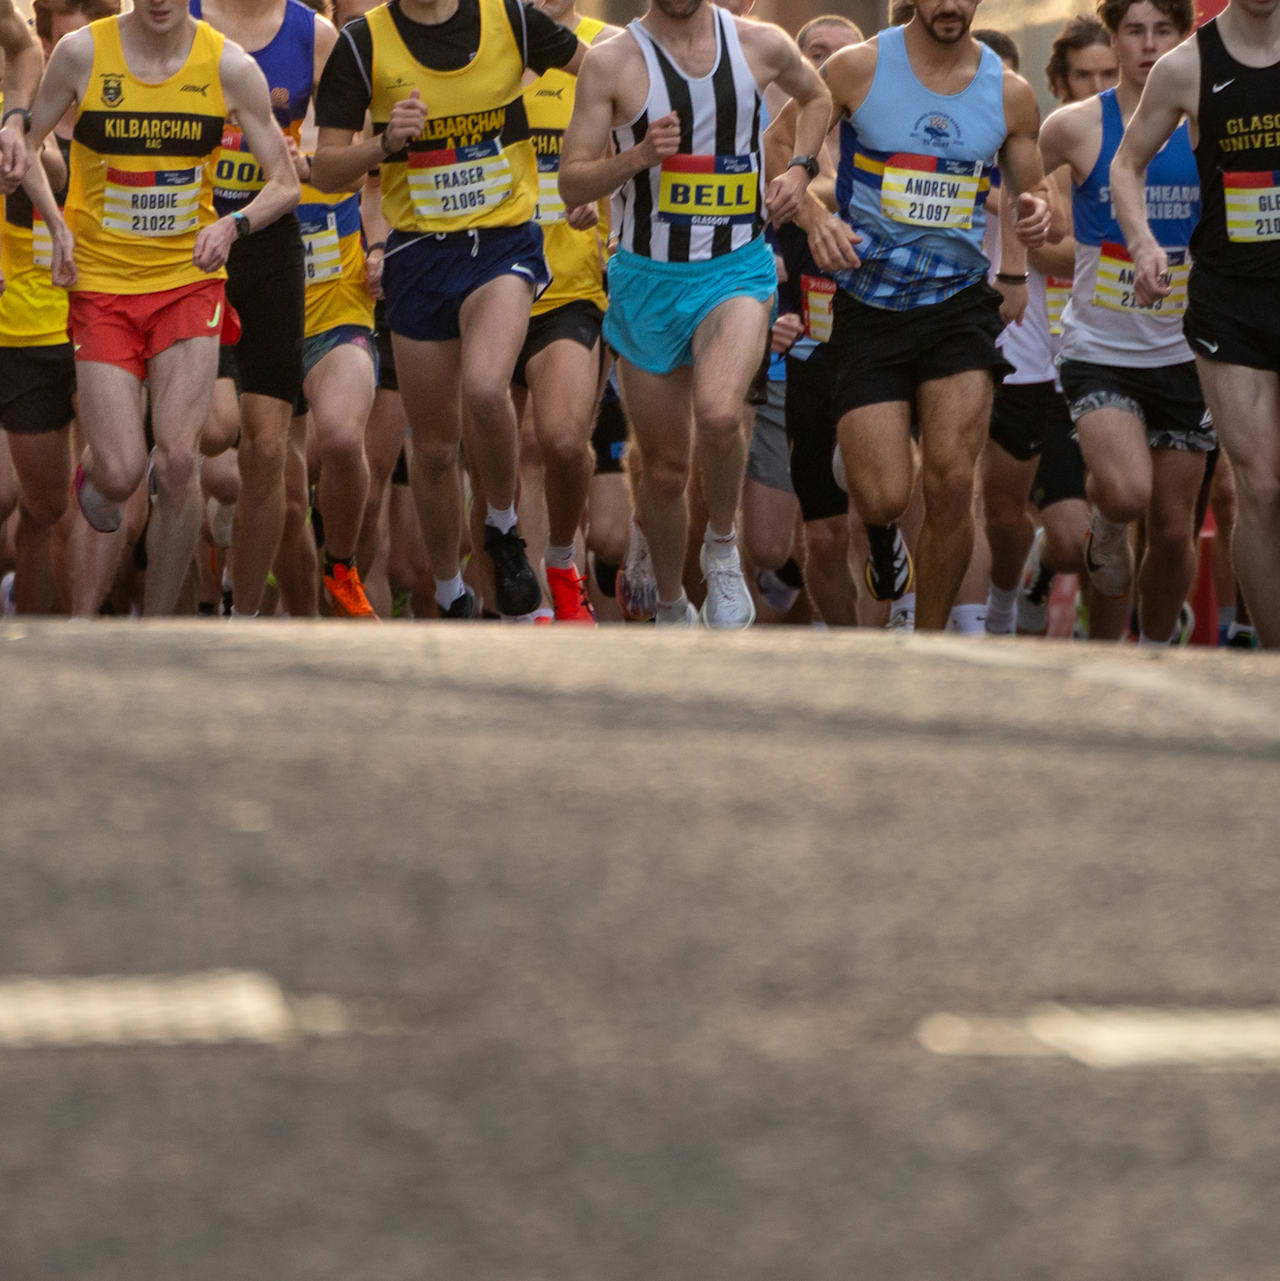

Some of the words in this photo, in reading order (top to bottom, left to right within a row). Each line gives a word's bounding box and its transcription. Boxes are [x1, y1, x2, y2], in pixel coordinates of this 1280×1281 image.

[104, 117, 203, 141] KILBARCHAN
[433, 166, 485, 190] FRASER
[904, 178, 961, 199] ANDREW
[131, 192, 178, 209] ROBBIE
[441, 189, 486, 212] 21085
[670, 183, 750, 207] BELL
[1099, 185, 1200, 203] SHEARN
[908, 202, 952, 222] 21097
[131, 215, 176, 231] 21022
